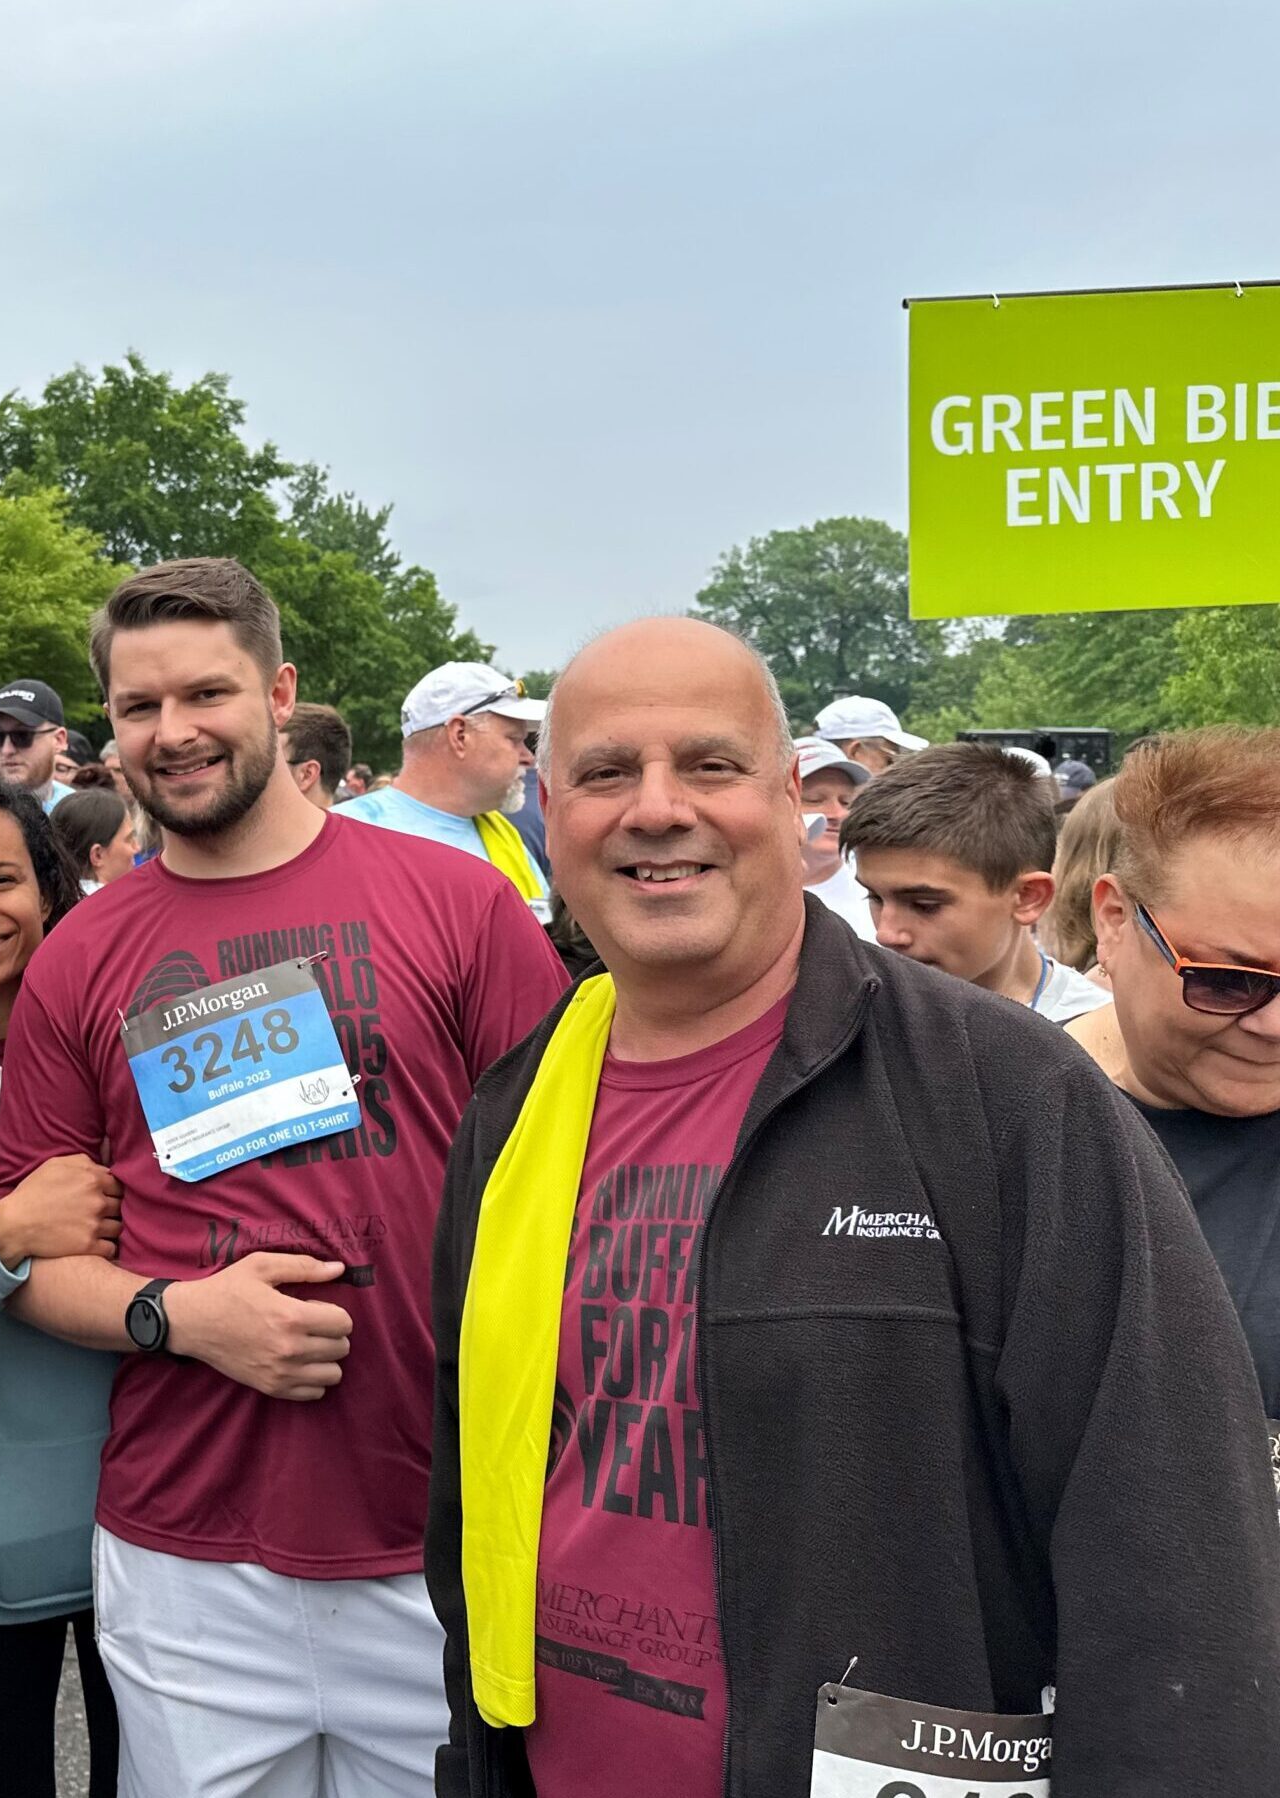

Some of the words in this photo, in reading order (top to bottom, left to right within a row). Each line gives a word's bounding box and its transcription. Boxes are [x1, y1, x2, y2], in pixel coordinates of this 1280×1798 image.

[930, 387, 1156, 456] GREEN
[1006, 459, 1227, 527] ENTRY
[217, 924, 336, 977] RUNNING
[340, 921, 370, 956] IN
[162, 982, 269, 1032] J.P.Morgan
[160, 1008, 299, 1094] 3248
[333, 1014, 387, 1076] 05
[208, 1081, 244, 1101] Buffalo
[246, 1069, 272, 1087] 2023
[216, 1147, 245, 1165] GOOD
[246, 1137, 268, 1153] FOR
[269, 1128, 292, 1144] ONE
[293, 1123, 308, 1138] (1)
[308, 1112, 350, 1132] T-SHIRT
[592, 1164, 720, 1222] RUNNIN
[859, 1213, 935, 1227] MERCHA
[856, 1227, 923, 1238] INSURANCE
[580, 1303, 670, 1402] FOR
[537, 1579, 721, 1648] MERCHANT
[538, 1612, 633, 1651] SURANCE
[637, 1637, 713, 1668] GROUP
[901, 1719, 1053, 1772] J.P.Morga
